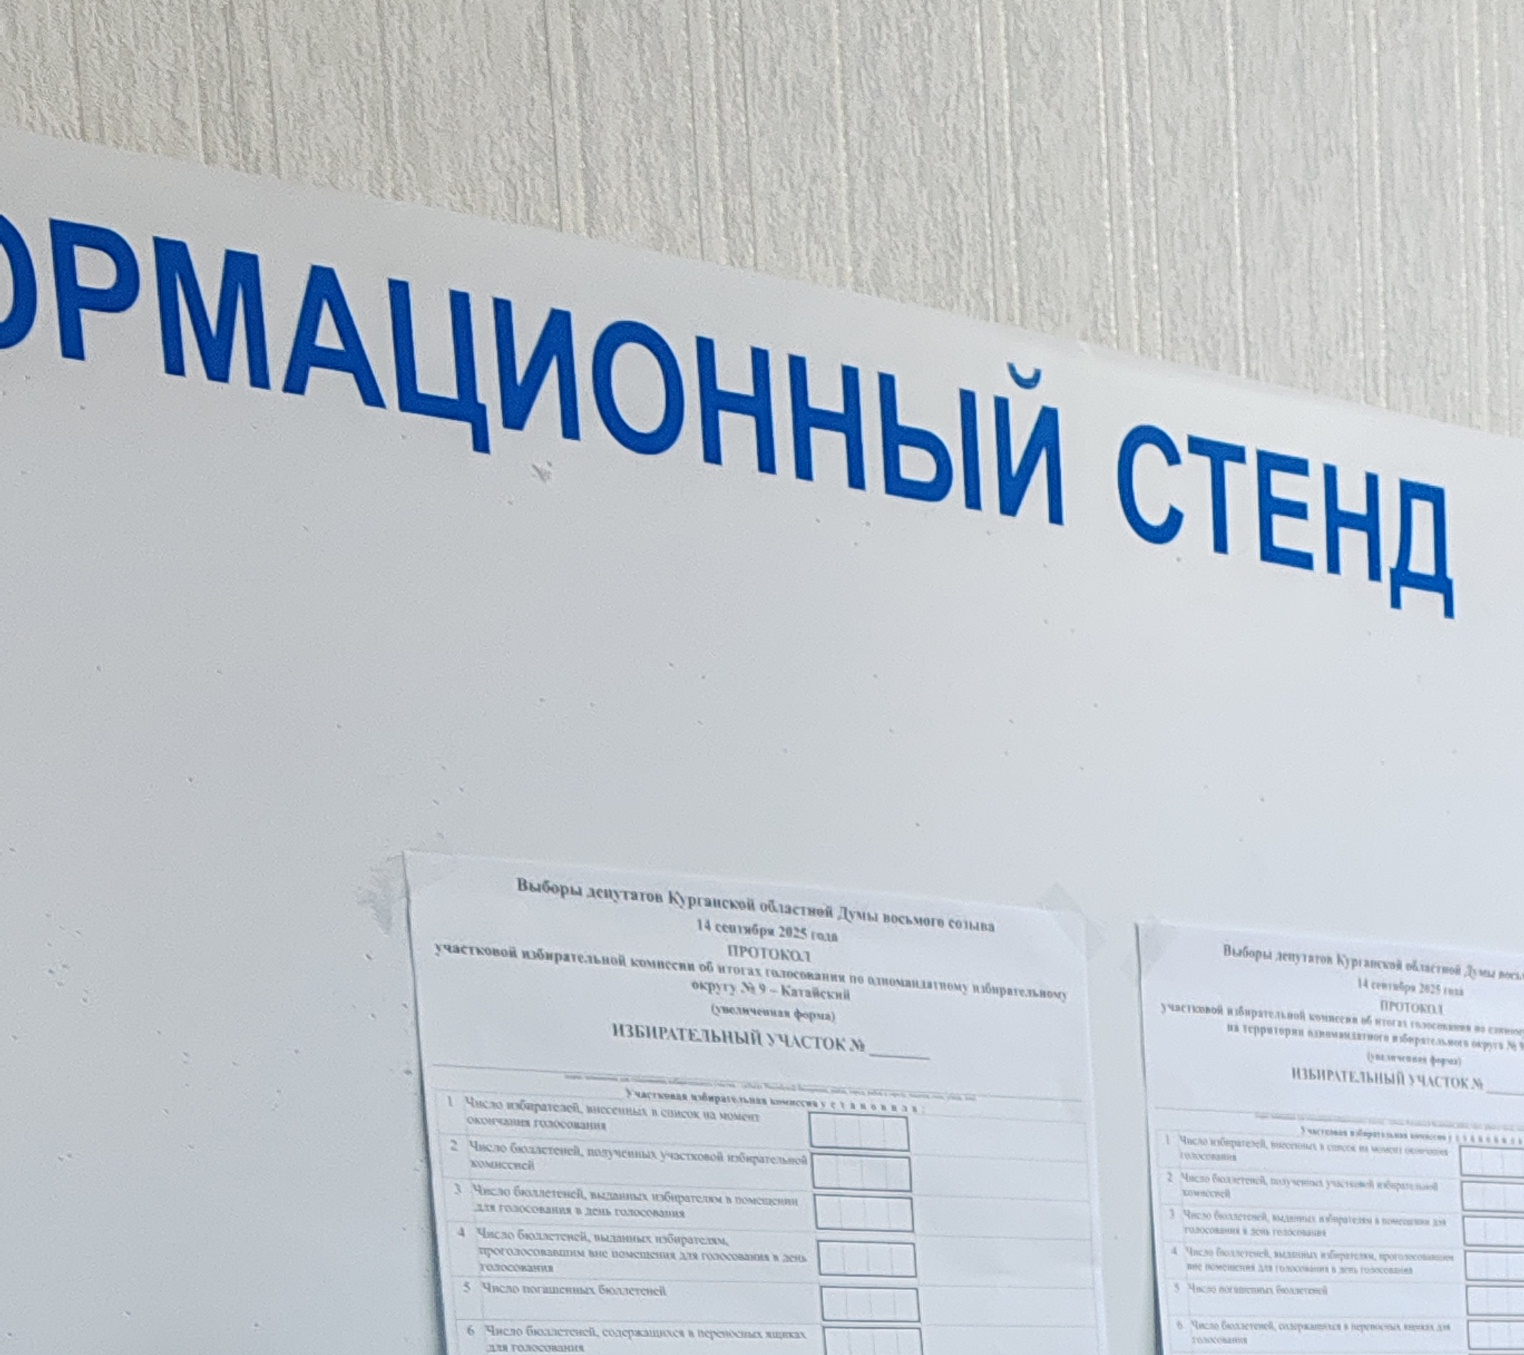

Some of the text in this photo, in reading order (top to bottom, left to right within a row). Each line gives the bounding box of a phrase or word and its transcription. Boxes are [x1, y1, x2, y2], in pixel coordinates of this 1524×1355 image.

[1118, 424, 1456, 619] СТЕНД
[517, 877, 995, 933] Выборы депутатов Курганской областной Думы восьмого созыва
[715, 921, 774, 940] сентября
[780, 924, 806, 940] 2025
[811, 929, 838, 944] года
[727, 943, 811, 963] ПРОТОКОЛ
[434, 943, 517, 959] участковой
[521, 946, 625, 967] избирательной
[630, 956, 694, 972] комиссии
[717, 962, 760, 977] итогах
[765, 966, 844, 983] голосования
[867, 973, 966, 995] одномандатному
[972, 978, 1067, 1002] избирательному
[692, 980, 735, 997] округу
[781, 982, 850, 1001] Катайский
[1380, 999, 1444, 1015] ПРОТОКОЛ
[612, 1022, 761, 1046] ИЗБИРАТЕЛЬНЫЙ
[768, 1031, 844, 1051] УЧАСТОК
[1291, 1066, 1404, 1086] ИЗБИРАТЕЛЬНЫЙ
[1409, 1072, 1467, 1090] УЧАСТОК
